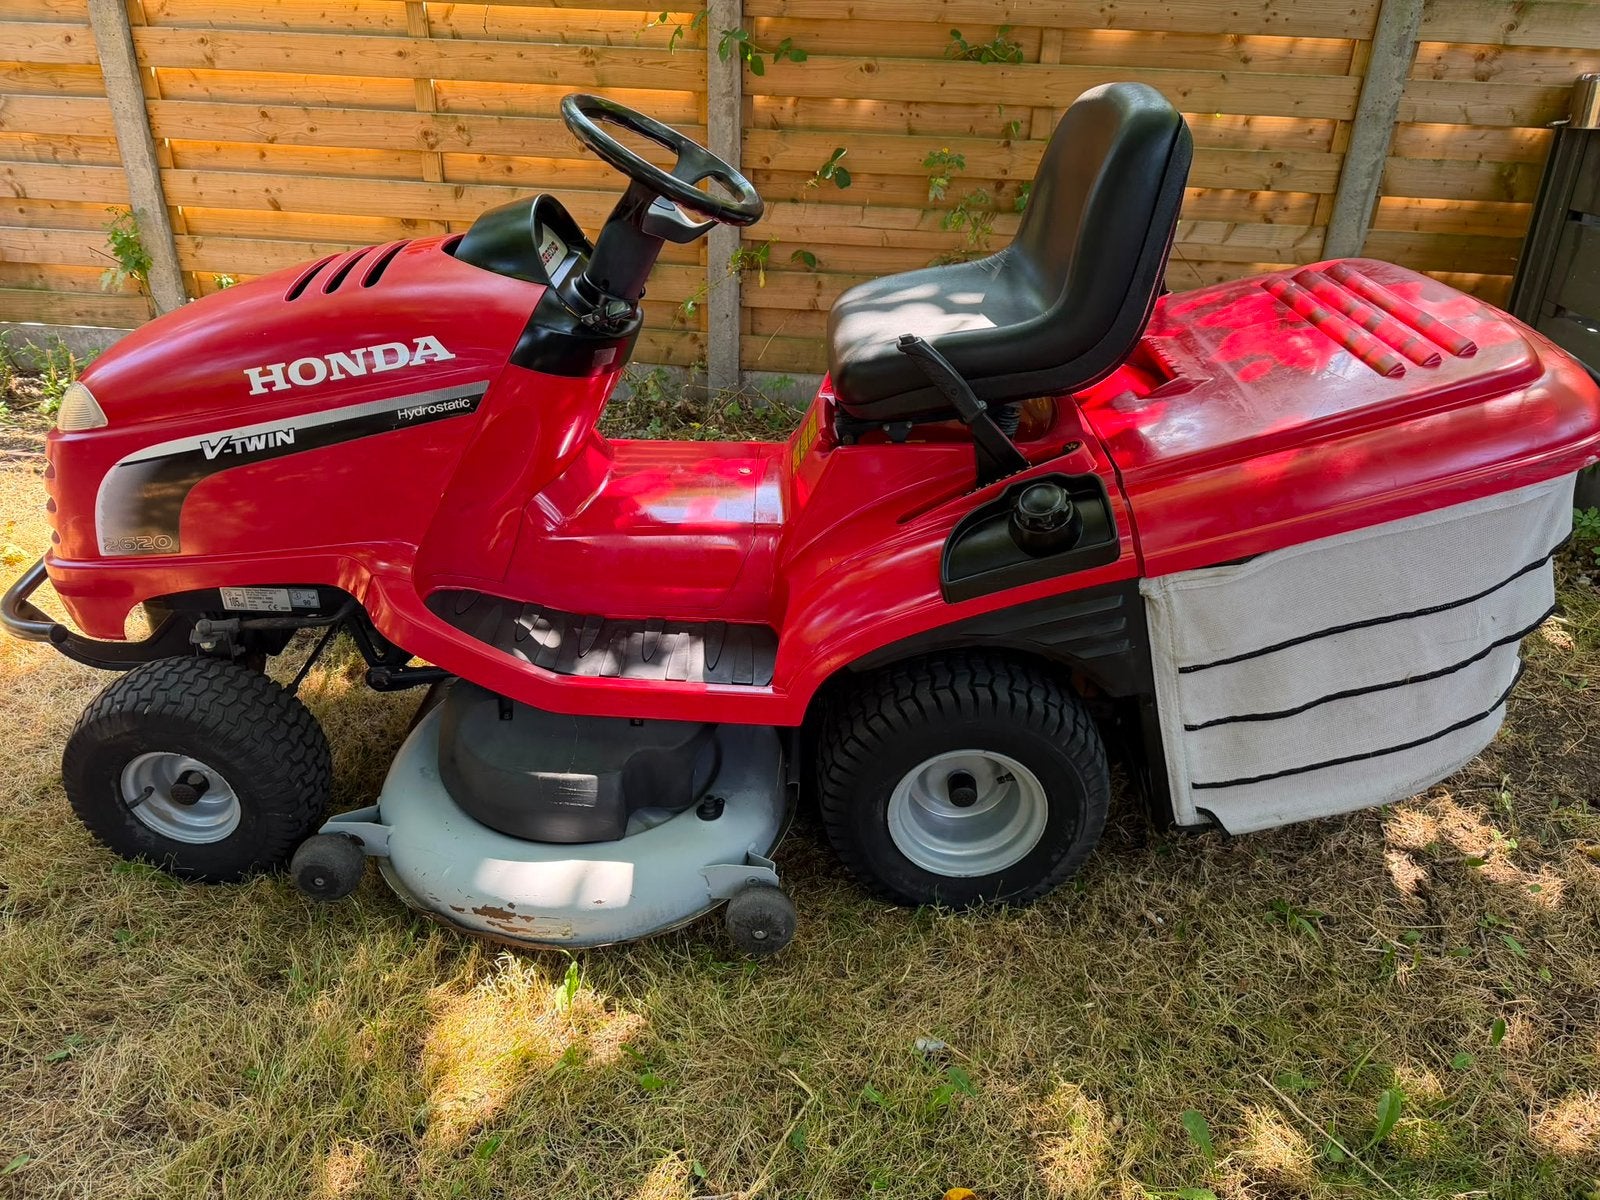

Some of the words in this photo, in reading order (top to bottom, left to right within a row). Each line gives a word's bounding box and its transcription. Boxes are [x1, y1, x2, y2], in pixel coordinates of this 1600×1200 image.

[243, 335, 456, 395] HONDA
[398, 398, 471, 420] Hydrostatic
[201, 428, 295, 460] V-TWIN
[104, 534, 173, 551] 2620
